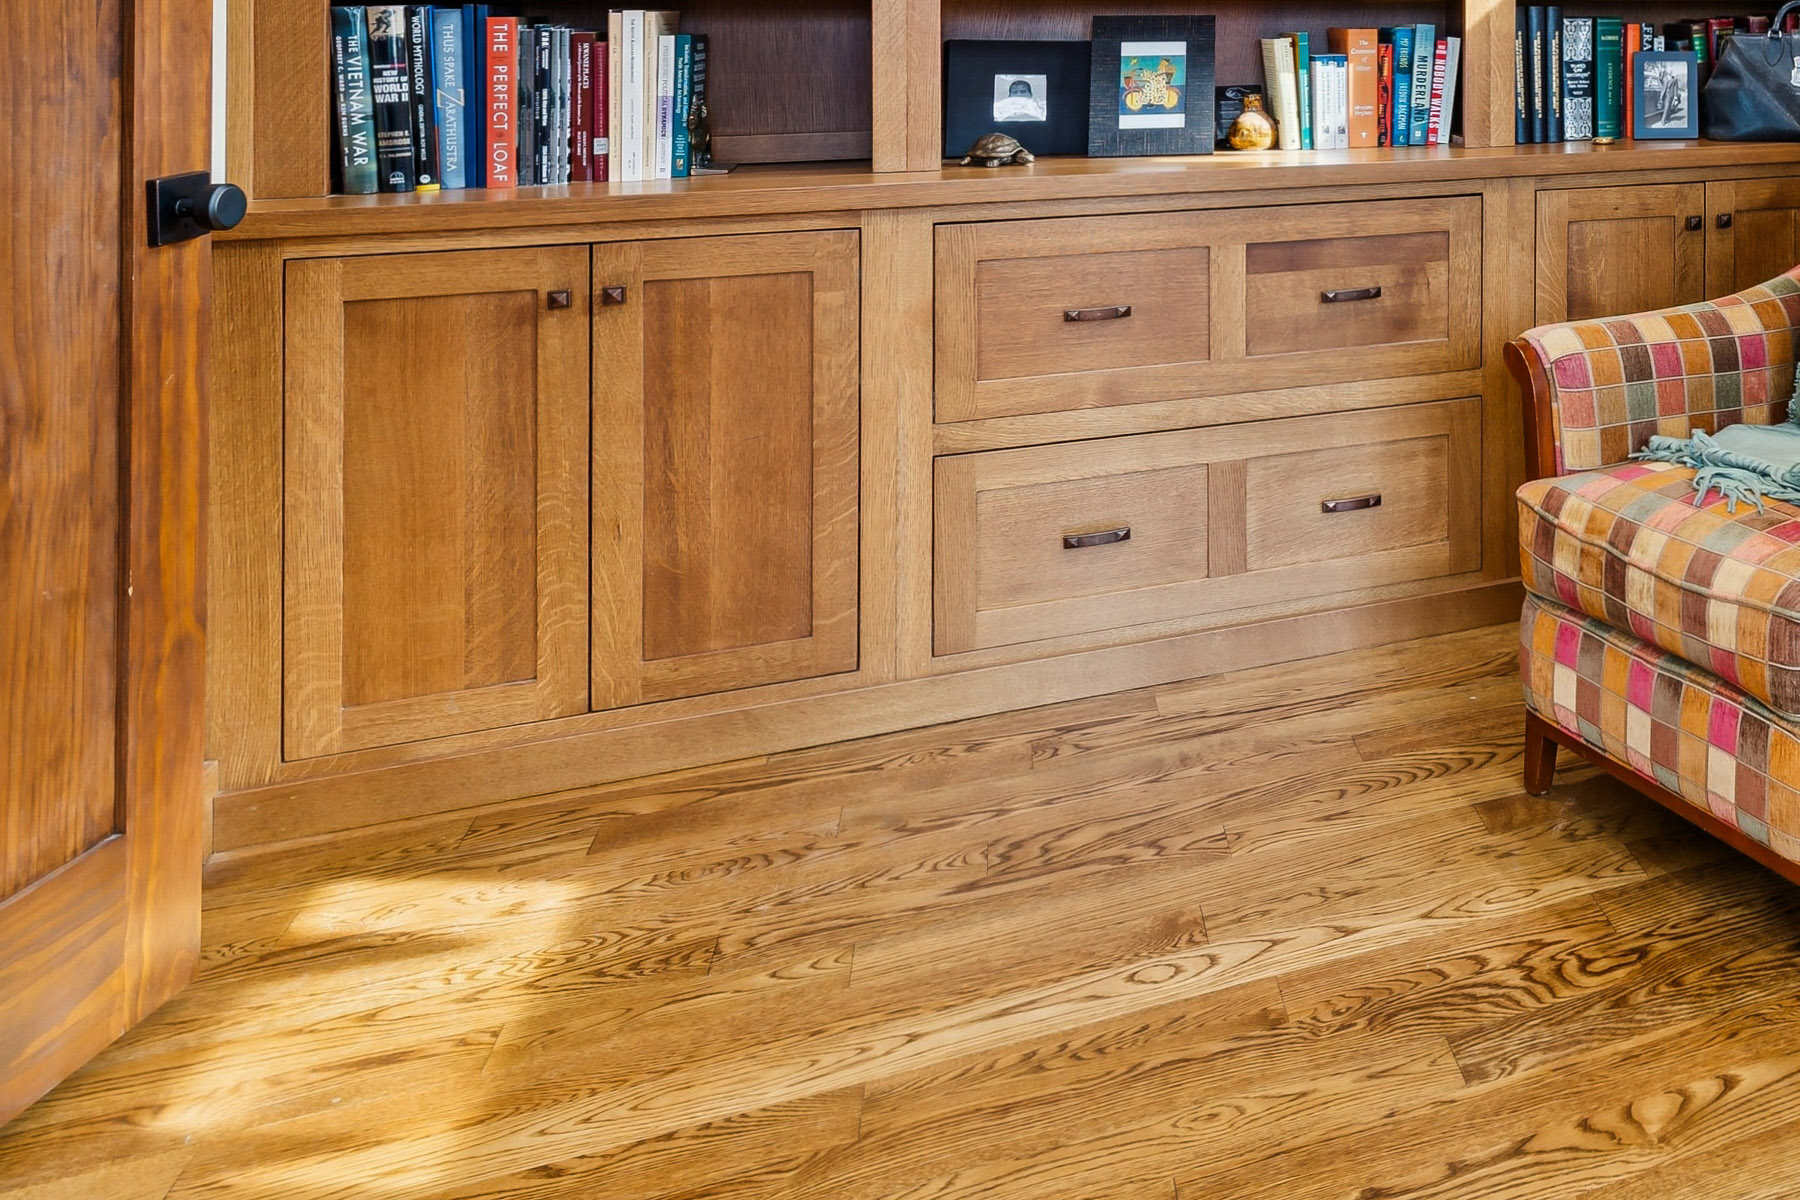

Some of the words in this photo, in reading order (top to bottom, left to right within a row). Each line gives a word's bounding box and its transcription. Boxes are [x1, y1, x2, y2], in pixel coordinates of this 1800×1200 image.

[348, 35, 357, 52] THE
[411, 15, 421, 44] WORLD
[442, 24, 454, 53] THUS
[494, 24, 508, 52] THE
[413, 45, 424, 95] MYTHOLOGY
[444, 56, 455, 87] SPAKE
[1432, 59, 1446, 96] NOBODY
[347, 56, 365, 125] VIETNAM
[493, 65, 508, 130] PERFECT
[1413, 55, 1428, 122] MURDERLAND
[436, 88, 464, 172] ZARATHUSTRA
[1429, 98, 1443, 128] WALKS
[352, 131, 368, 166] WAR
[494, 143, 508, 182] LOAF
